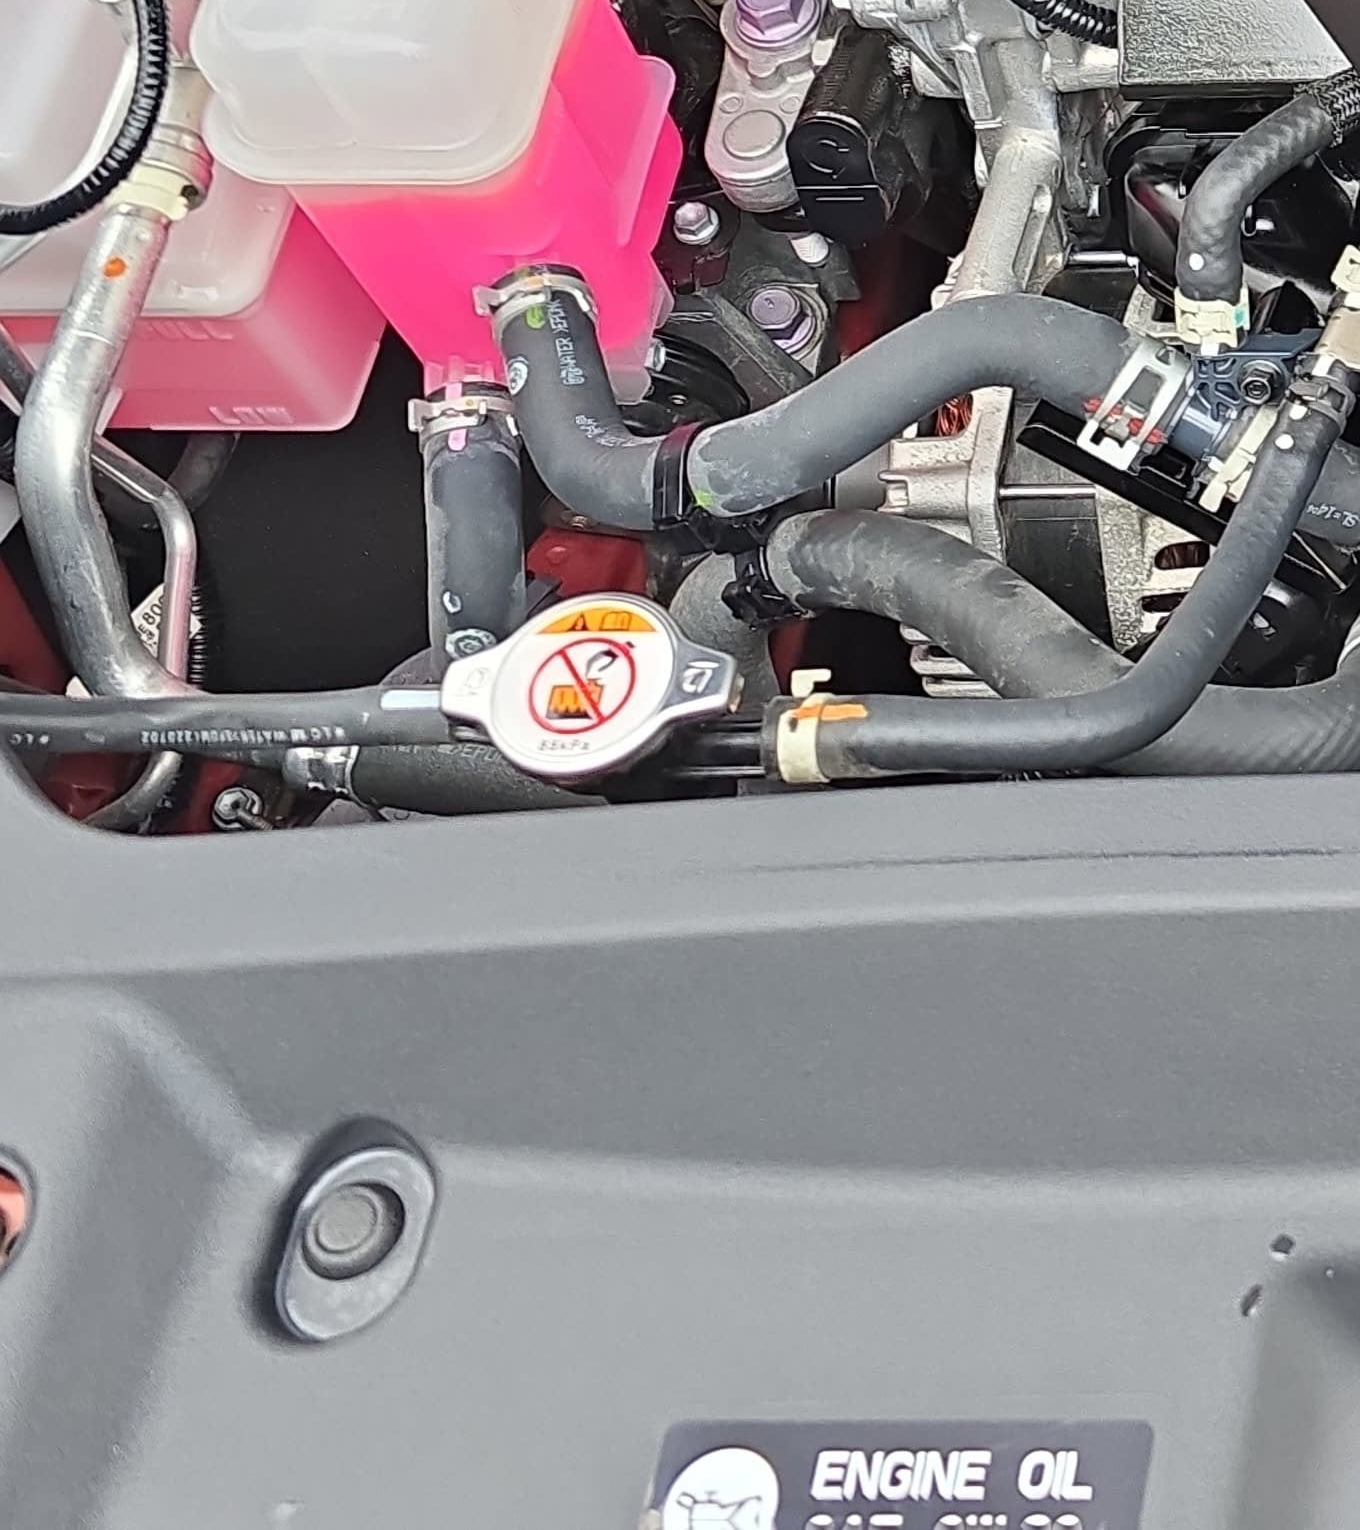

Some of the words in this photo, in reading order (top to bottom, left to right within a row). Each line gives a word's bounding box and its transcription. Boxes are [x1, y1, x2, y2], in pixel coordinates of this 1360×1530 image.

[208, 405, 295, 426] LOW
[808, 1448, 993, 1502] ENGINE
[1016, 1449, 1094, 1502] OIL
